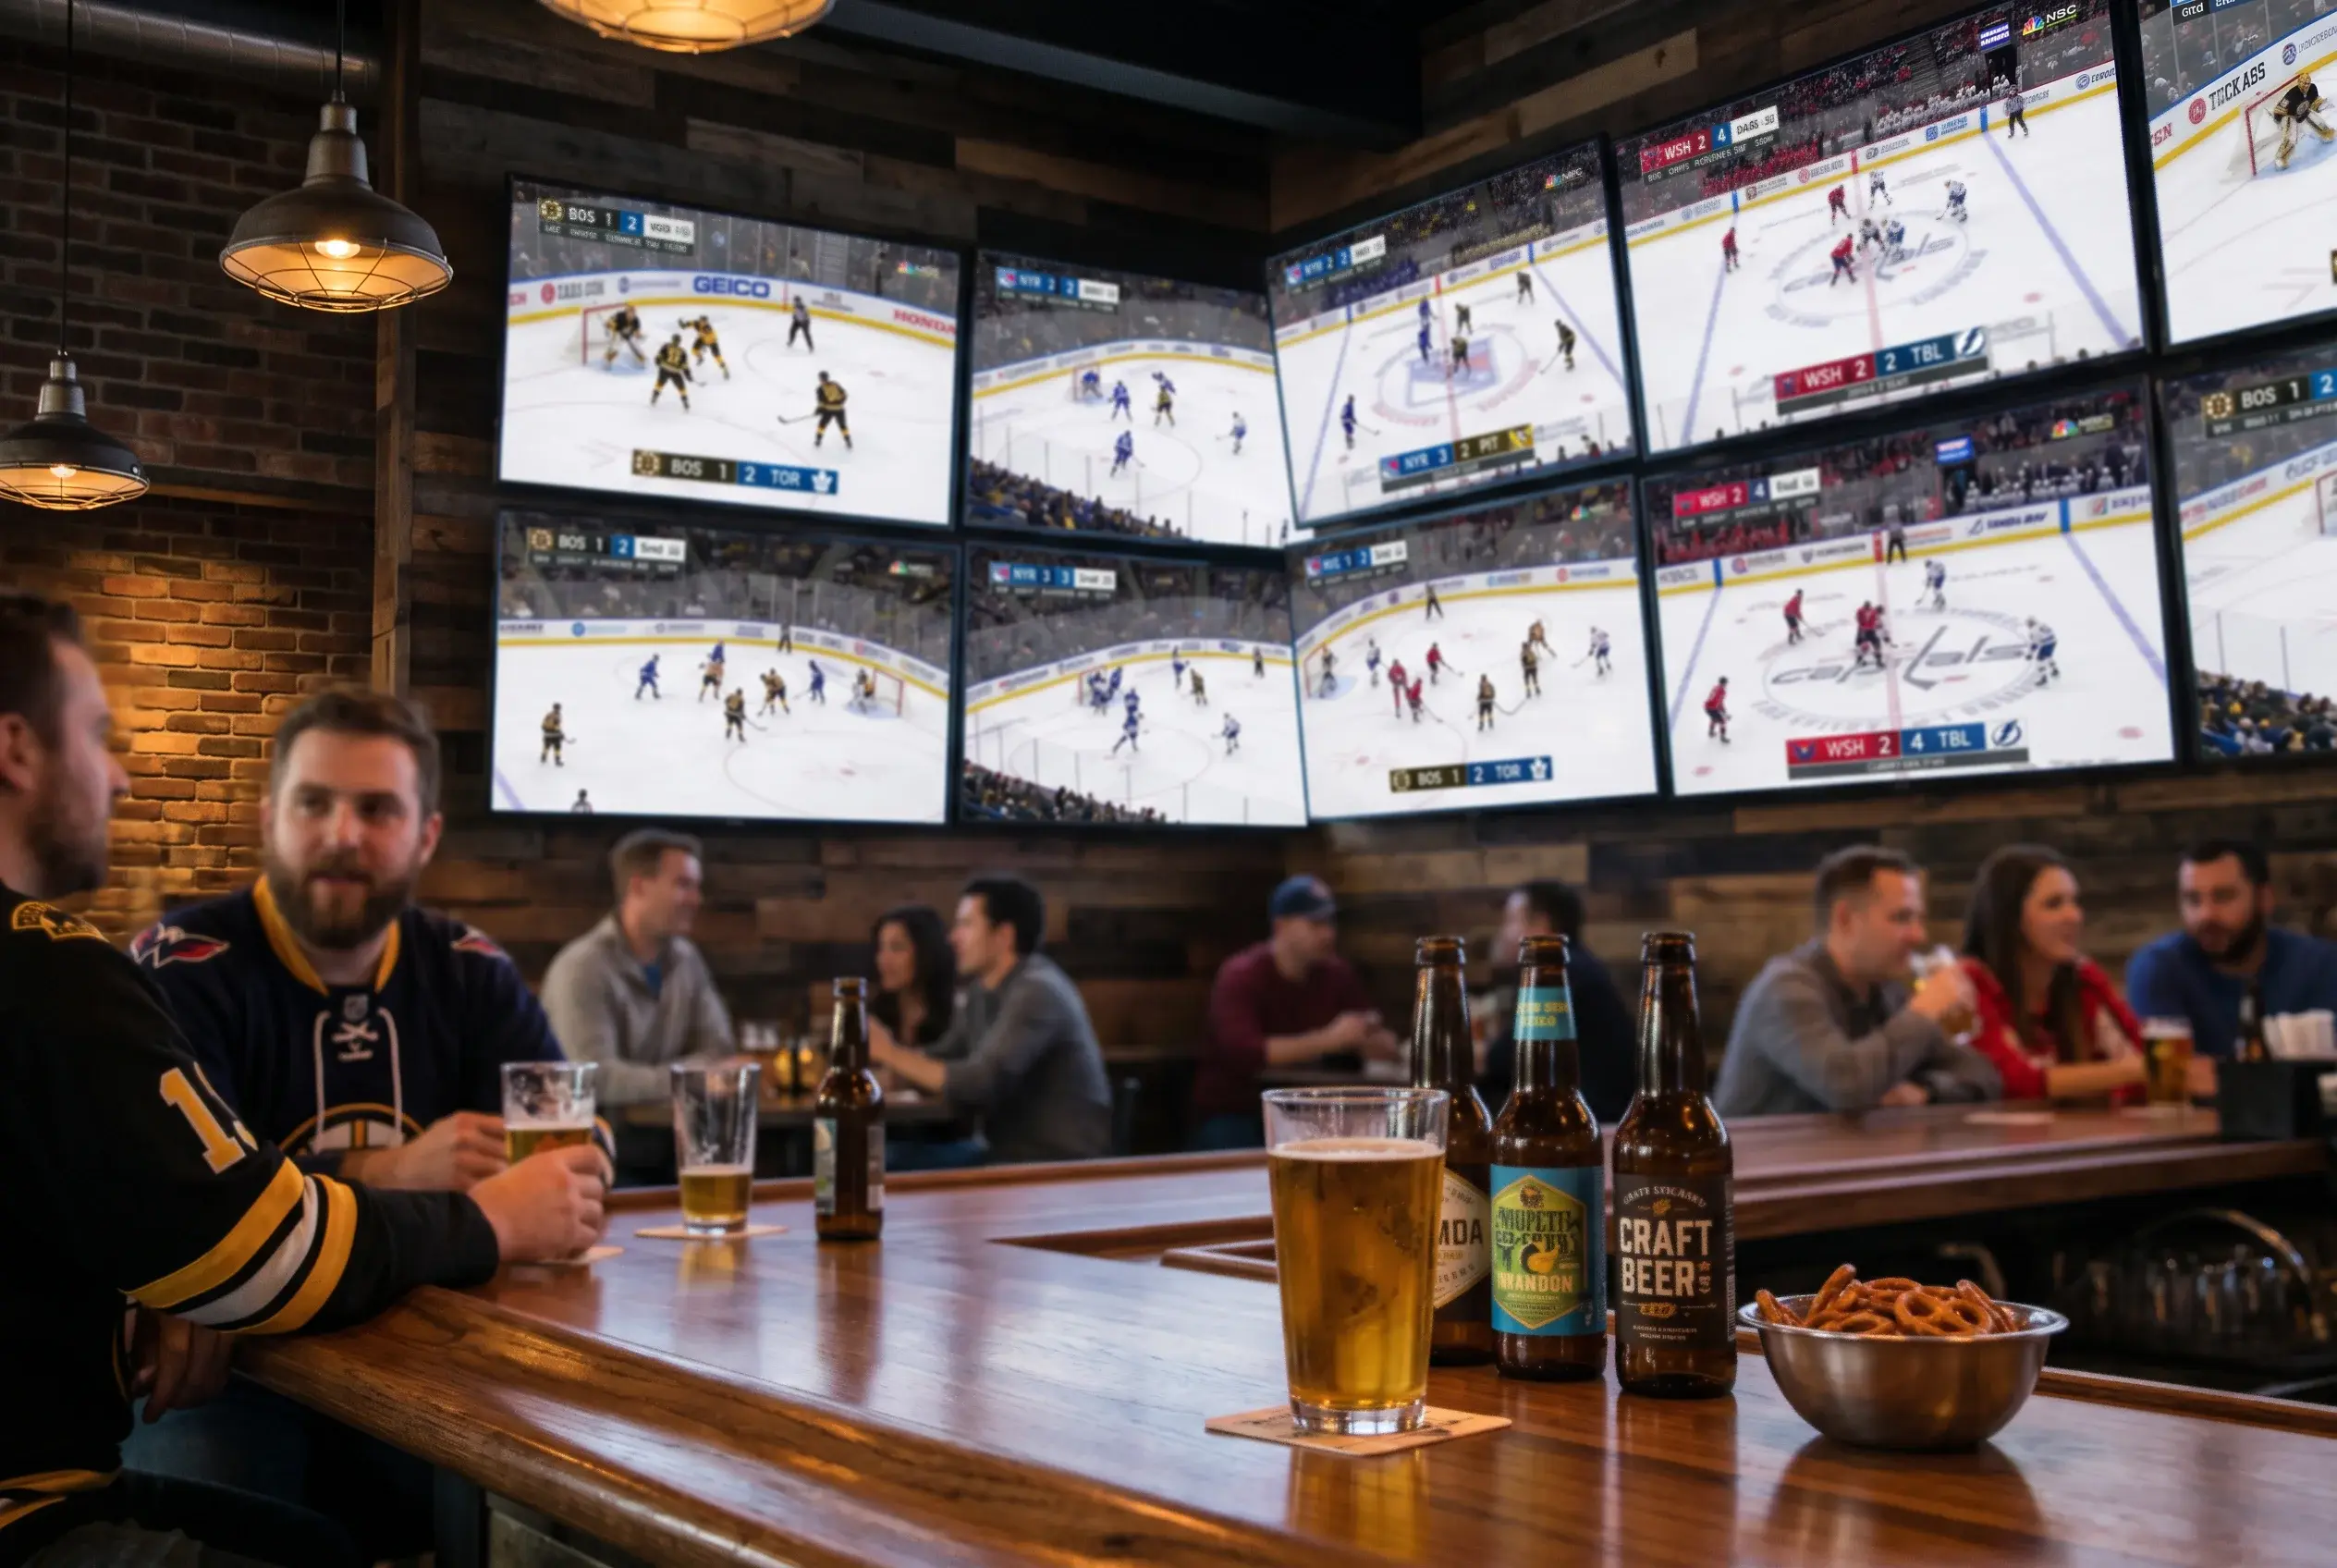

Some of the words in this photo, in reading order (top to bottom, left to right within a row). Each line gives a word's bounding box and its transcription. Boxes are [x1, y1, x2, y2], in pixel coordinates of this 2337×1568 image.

[2046, 5, 2077, 24] NSC
[1664, 140, 1692, 160] WSH
[1697, 135, 1707, 150] 2
[1717, 128, 1727, 142] 4
[569, 207, 596, 224] BOS
[605, 212, 613, 227] 1
[627, 215, 638, 231] 2
[692, 276, 771, 298] GEICO
[1804, 365, 1842, 388] WSH
[1854, 360, 1866, 378] 2
[1884, 352, 1896, 371] 2
[1909, 343, 1944, 364] TBL
[2241, 386, 2277, 410] BOS
[2289, 380, 2299, 399] 1
[2320, 374, 2334, 394] 2
[670, 459, 703, 476] BOS
[718, 462, 727, 480] 1
[744, 465, 756, 483] 2
[770, 468, 801, 486] TOR
[1698, 489, 1727, 508] WSH
[1731, 487, 1743, 504] 2
[1754, 483, 1765, 498] 4
[558, 534, 586, 551] BOS
[596, 537, 604, 553] 1
[618, 538, 629, 555] 2
[1826, 740, 1865, 758] WSH
[1878, 735, 1891, 755] 2
[1910, 732, 1925, 751] 4
[1939, 729, 1972, 748] TBL
[1417, 770, 1442, 787] BOS
[1451, 768, 1460, 784] 1
[1474, 766, 1485, 783] 2
[1495, 764, 1522, 779] TOR
[1620, 1216, 1712, 1256] CRAFT
[1621, 1256, 1695, 1297] BEER
